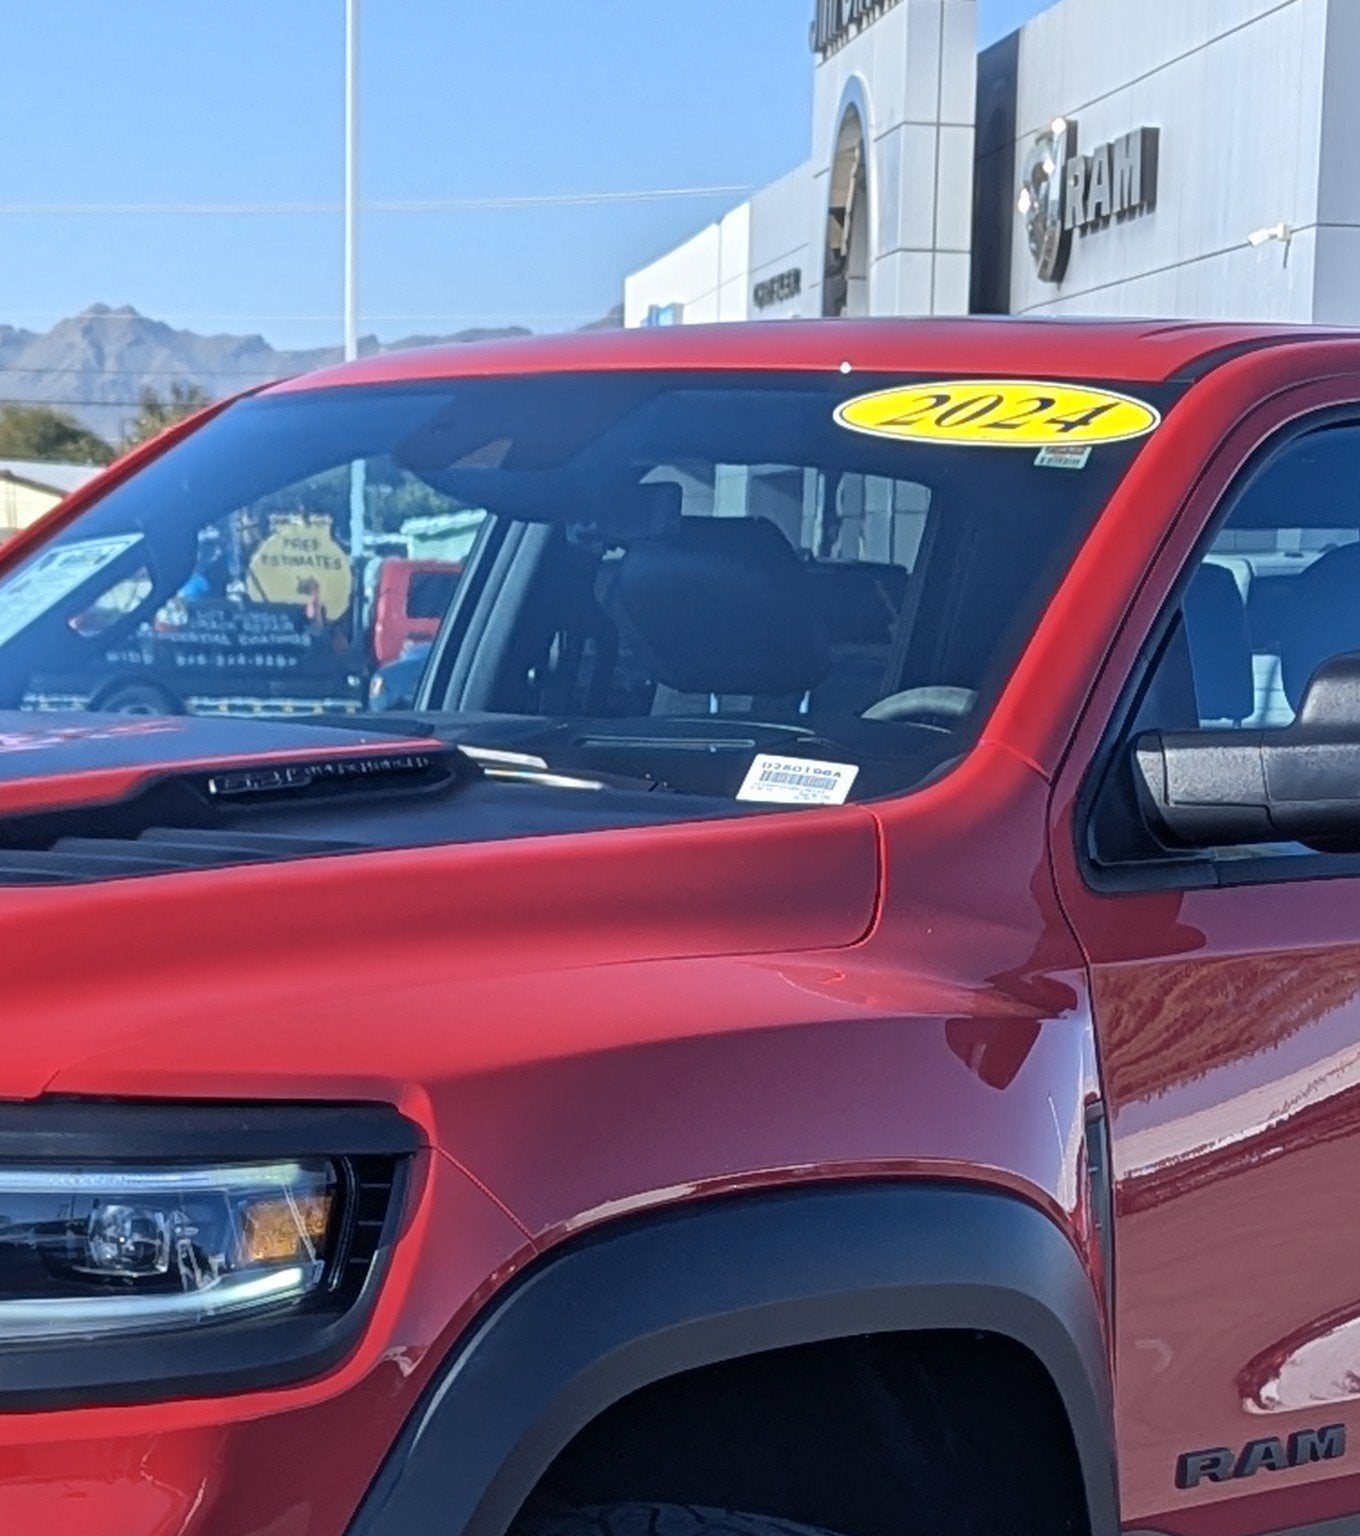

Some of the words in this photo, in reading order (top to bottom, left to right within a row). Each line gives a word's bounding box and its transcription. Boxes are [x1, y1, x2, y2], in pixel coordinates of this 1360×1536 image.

[1064, 127, 1154, 236] RAM
[873, 393, 1122, 434] 2024
[1174, 1423, 1347, 1490] RAM
